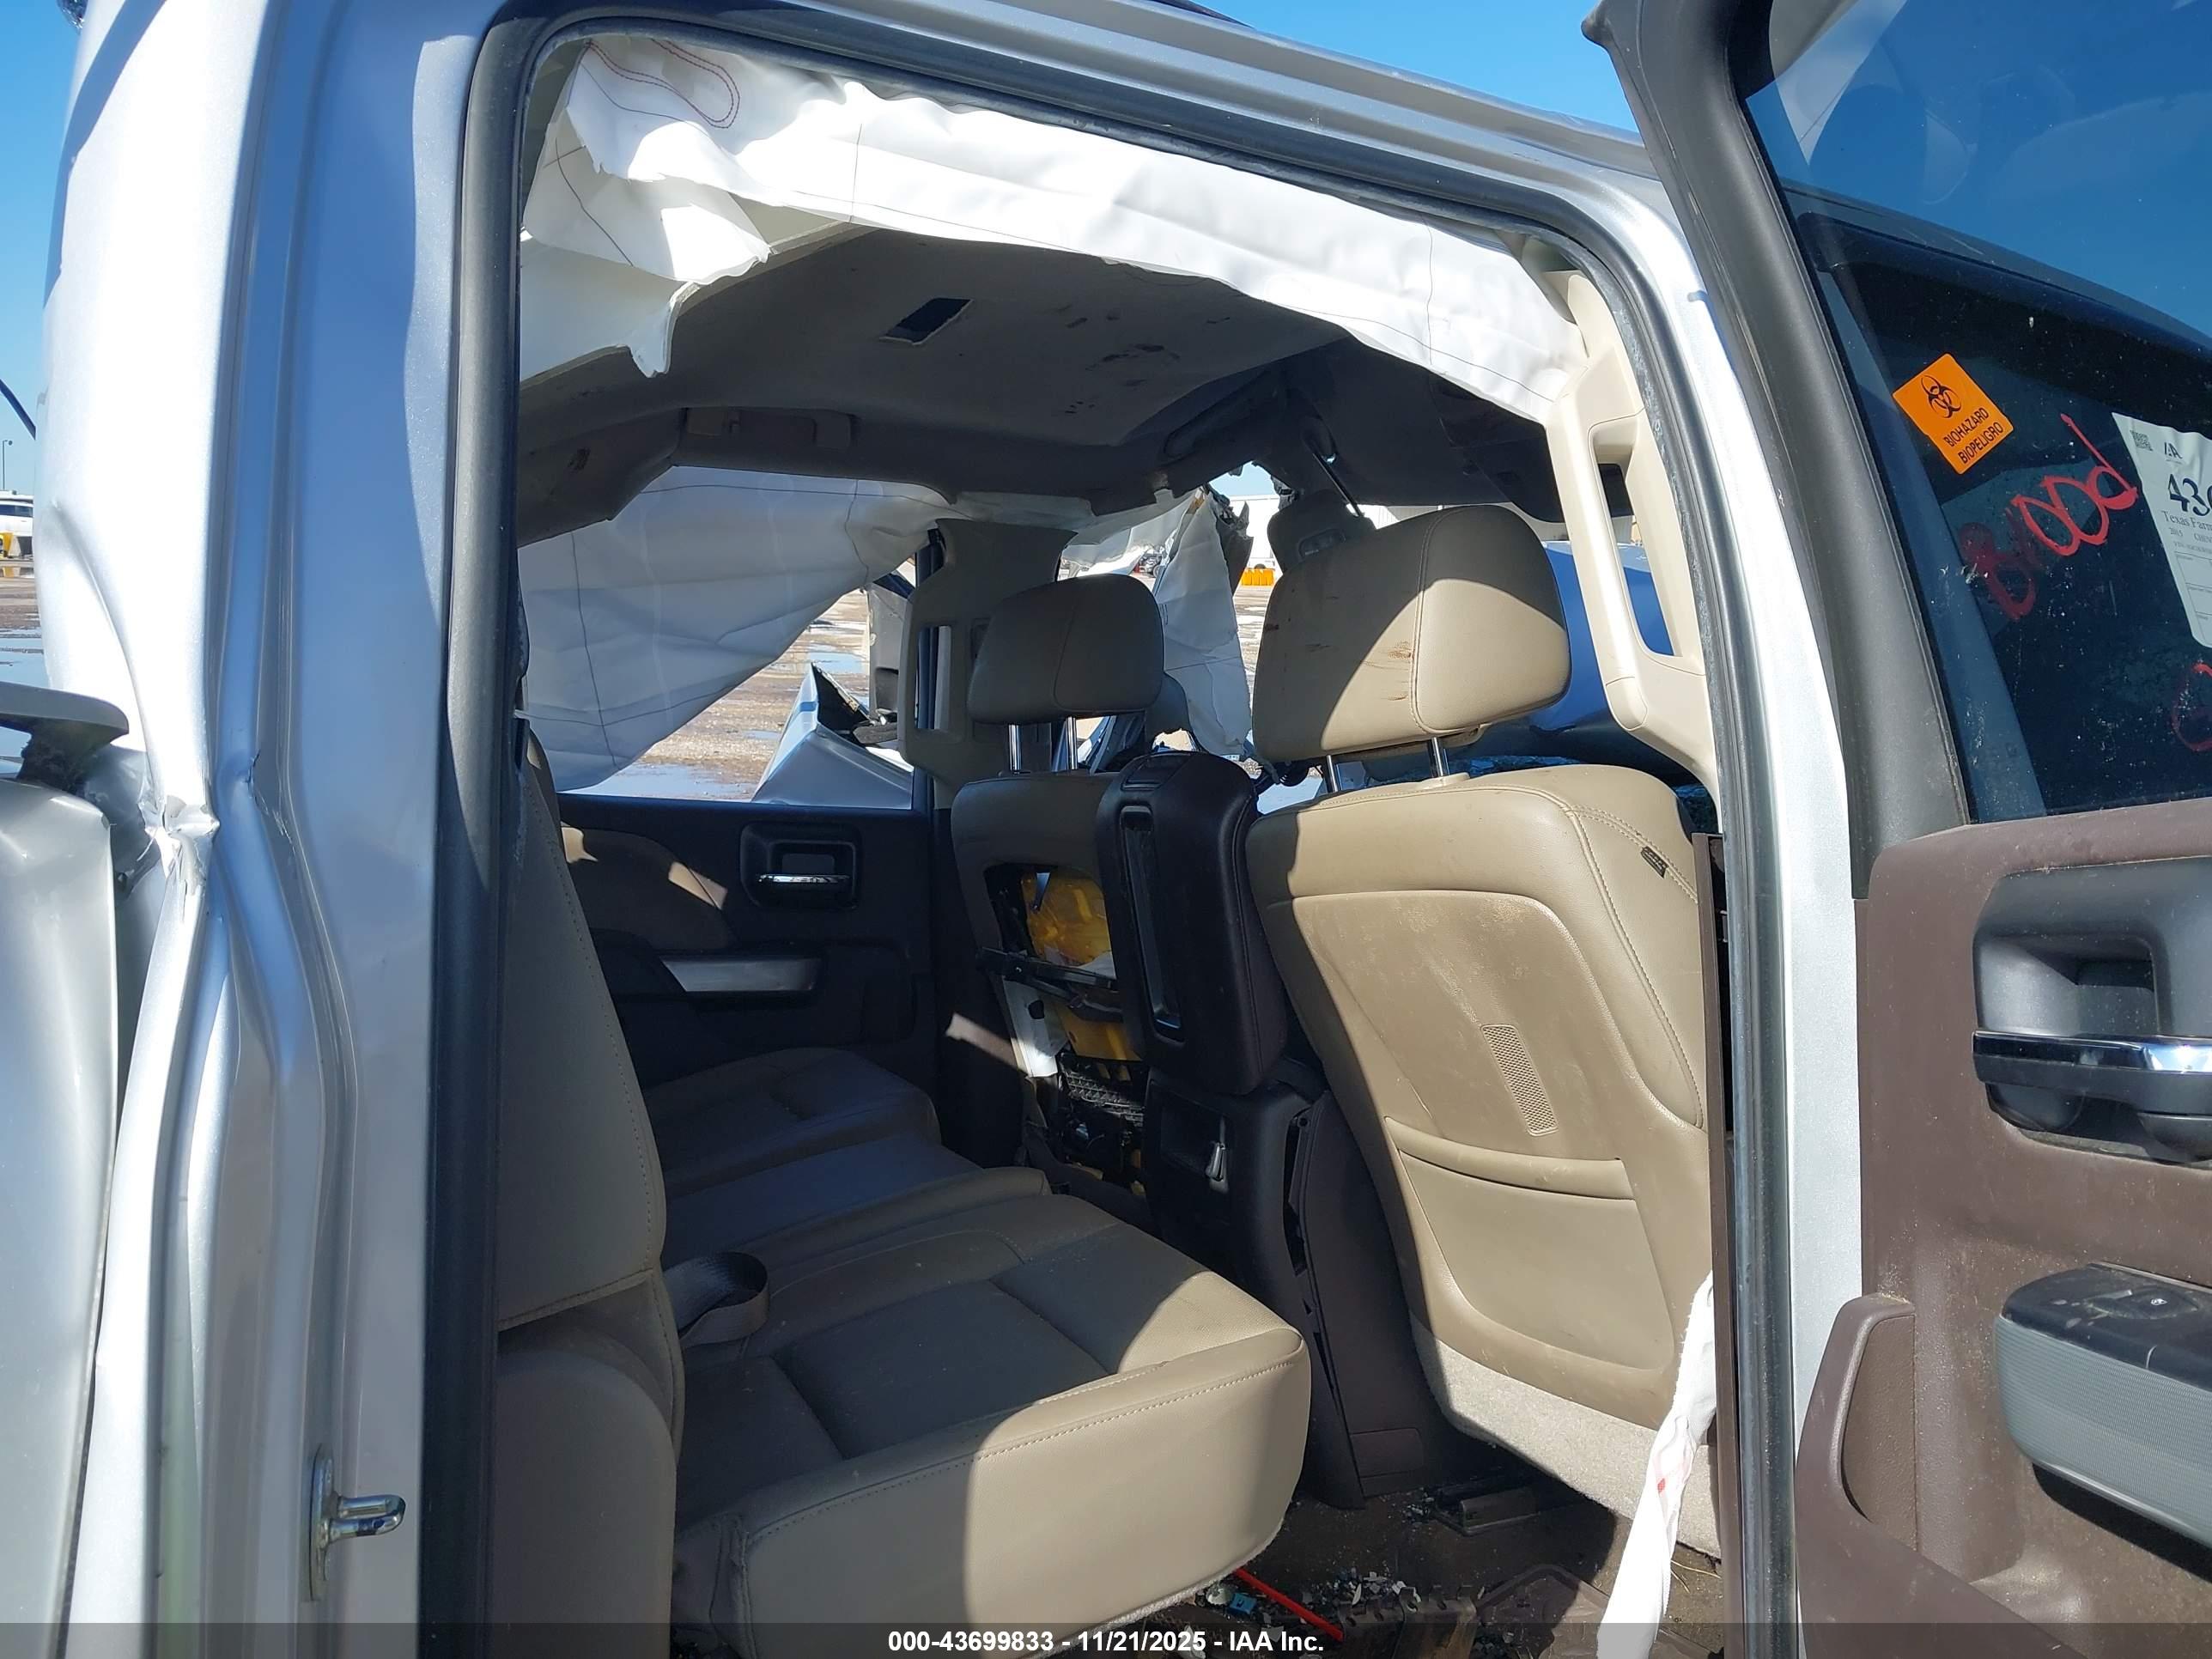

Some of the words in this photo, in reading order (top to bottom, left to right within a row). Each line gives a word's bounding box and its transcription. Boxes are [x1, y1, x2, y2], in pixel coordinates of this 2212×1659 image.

[1942, 407, 1990, 447] BIOHAZARD
[1957, 421, 2004, 465] BIOPELIGRO
[2161, 510, 2191, 526] Texas
